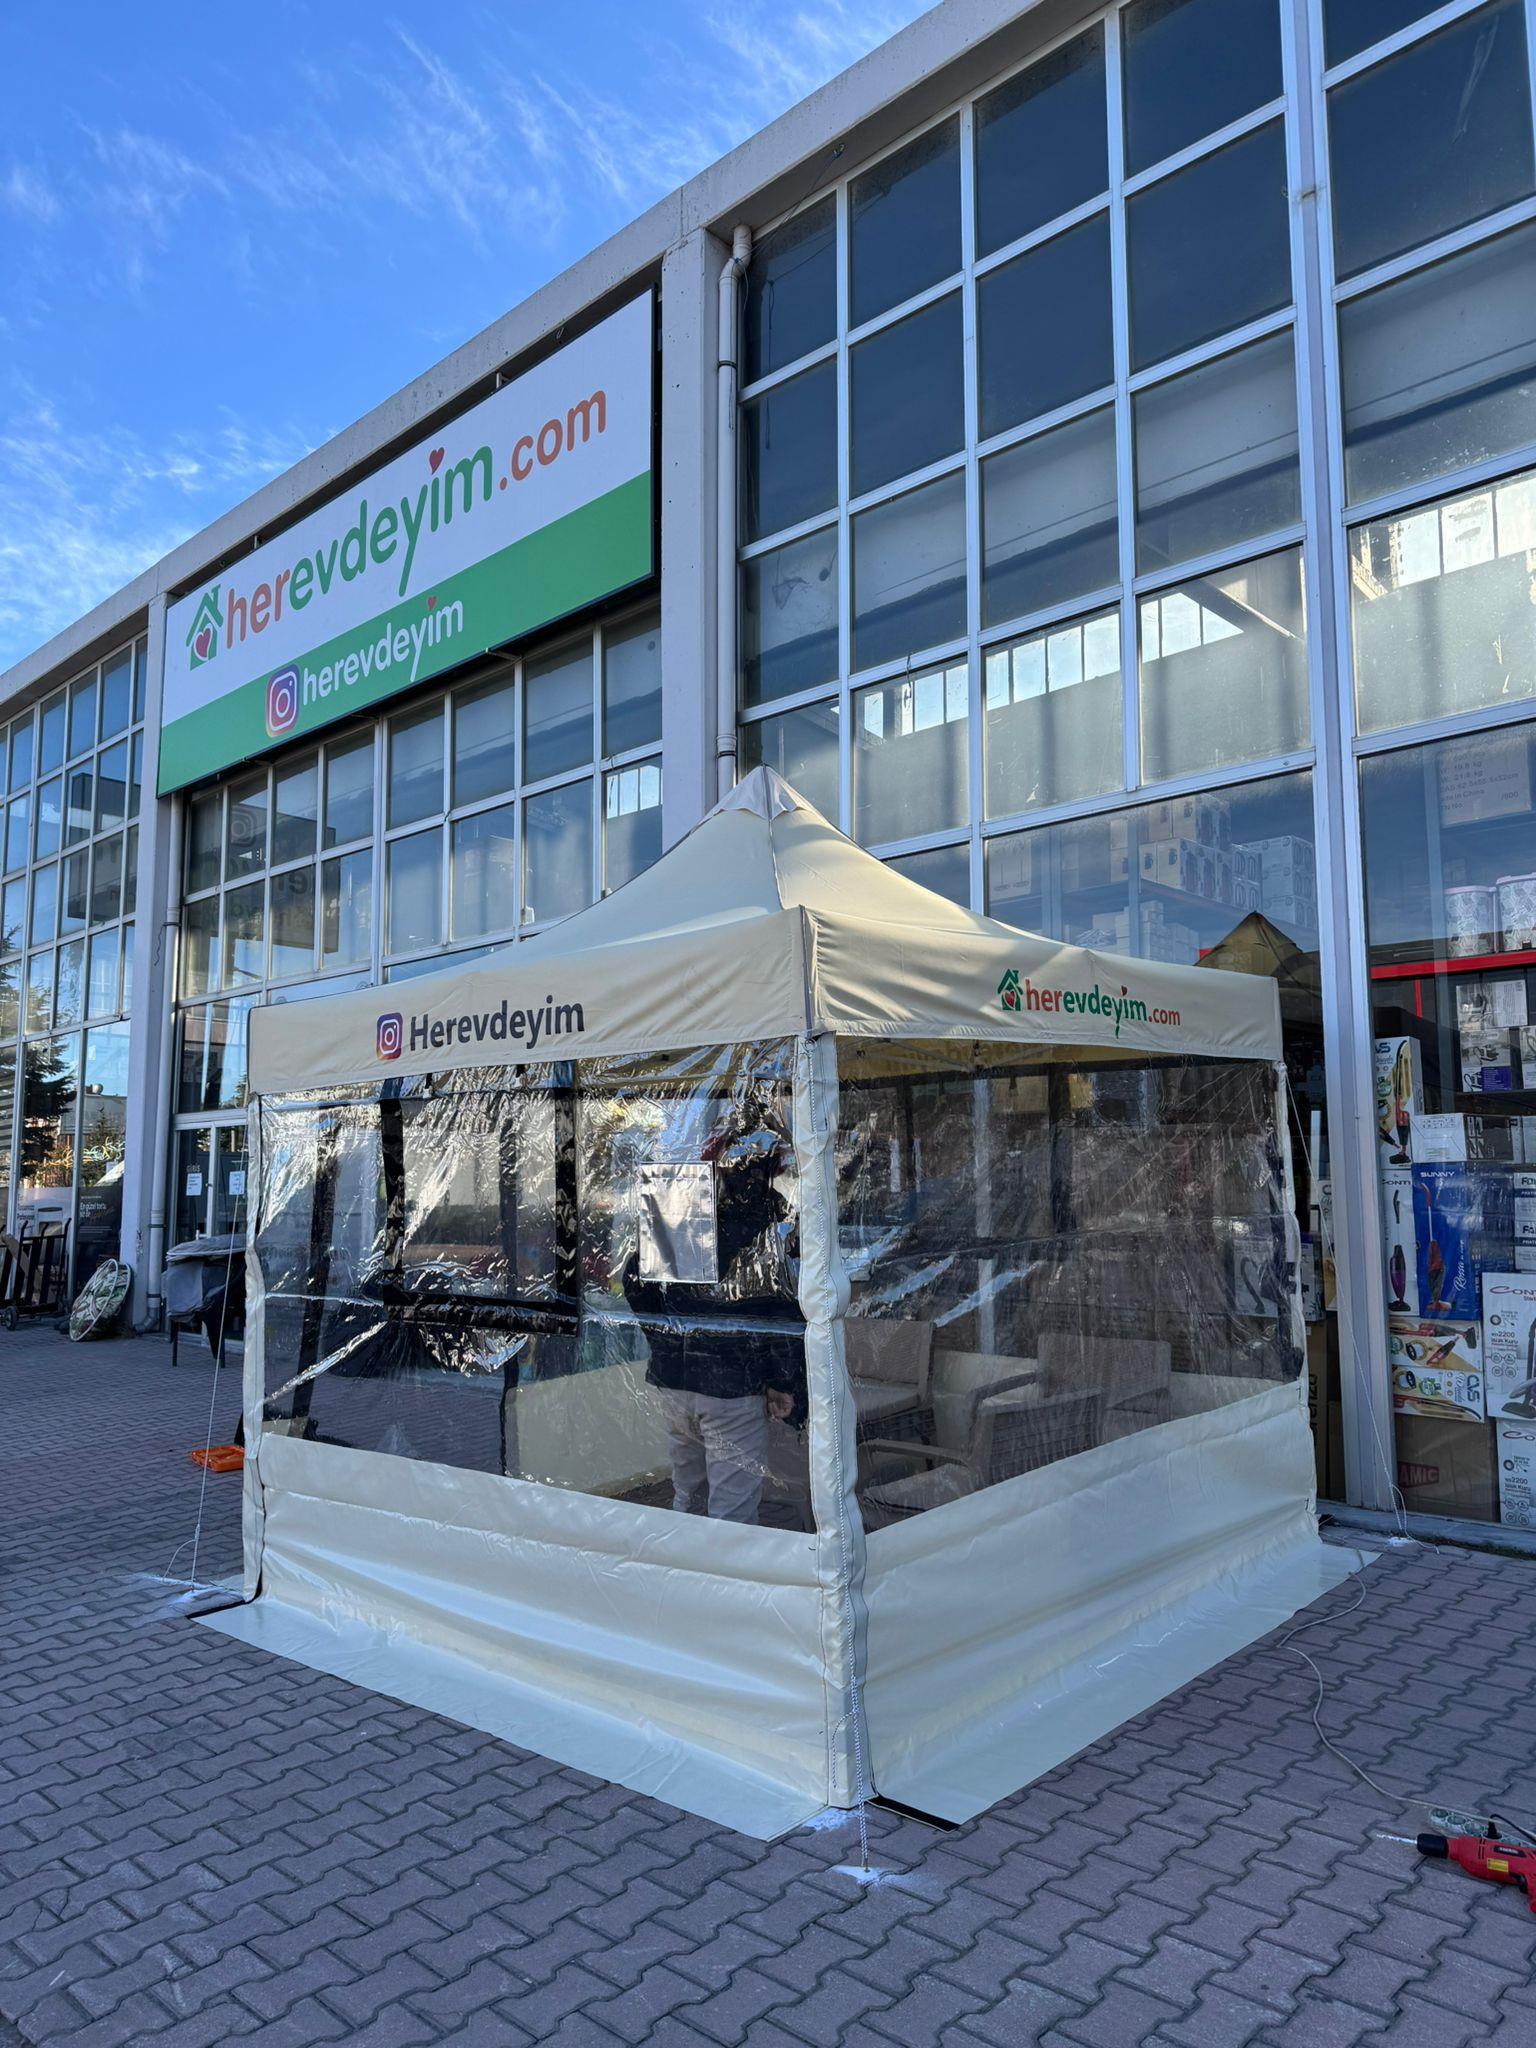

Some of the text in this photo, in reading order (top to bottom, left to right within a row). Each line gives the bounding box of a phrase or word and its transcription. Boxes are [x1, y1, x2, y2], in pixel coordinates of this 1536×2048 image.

[226, 390, 607, 649] herevdeyim.com
[303, 597, 464, 706] herevdeyim
[410, 995, 585, 1051] Herevdeyim
[1025, 979, 1181, 1039] herevdeyim.com
